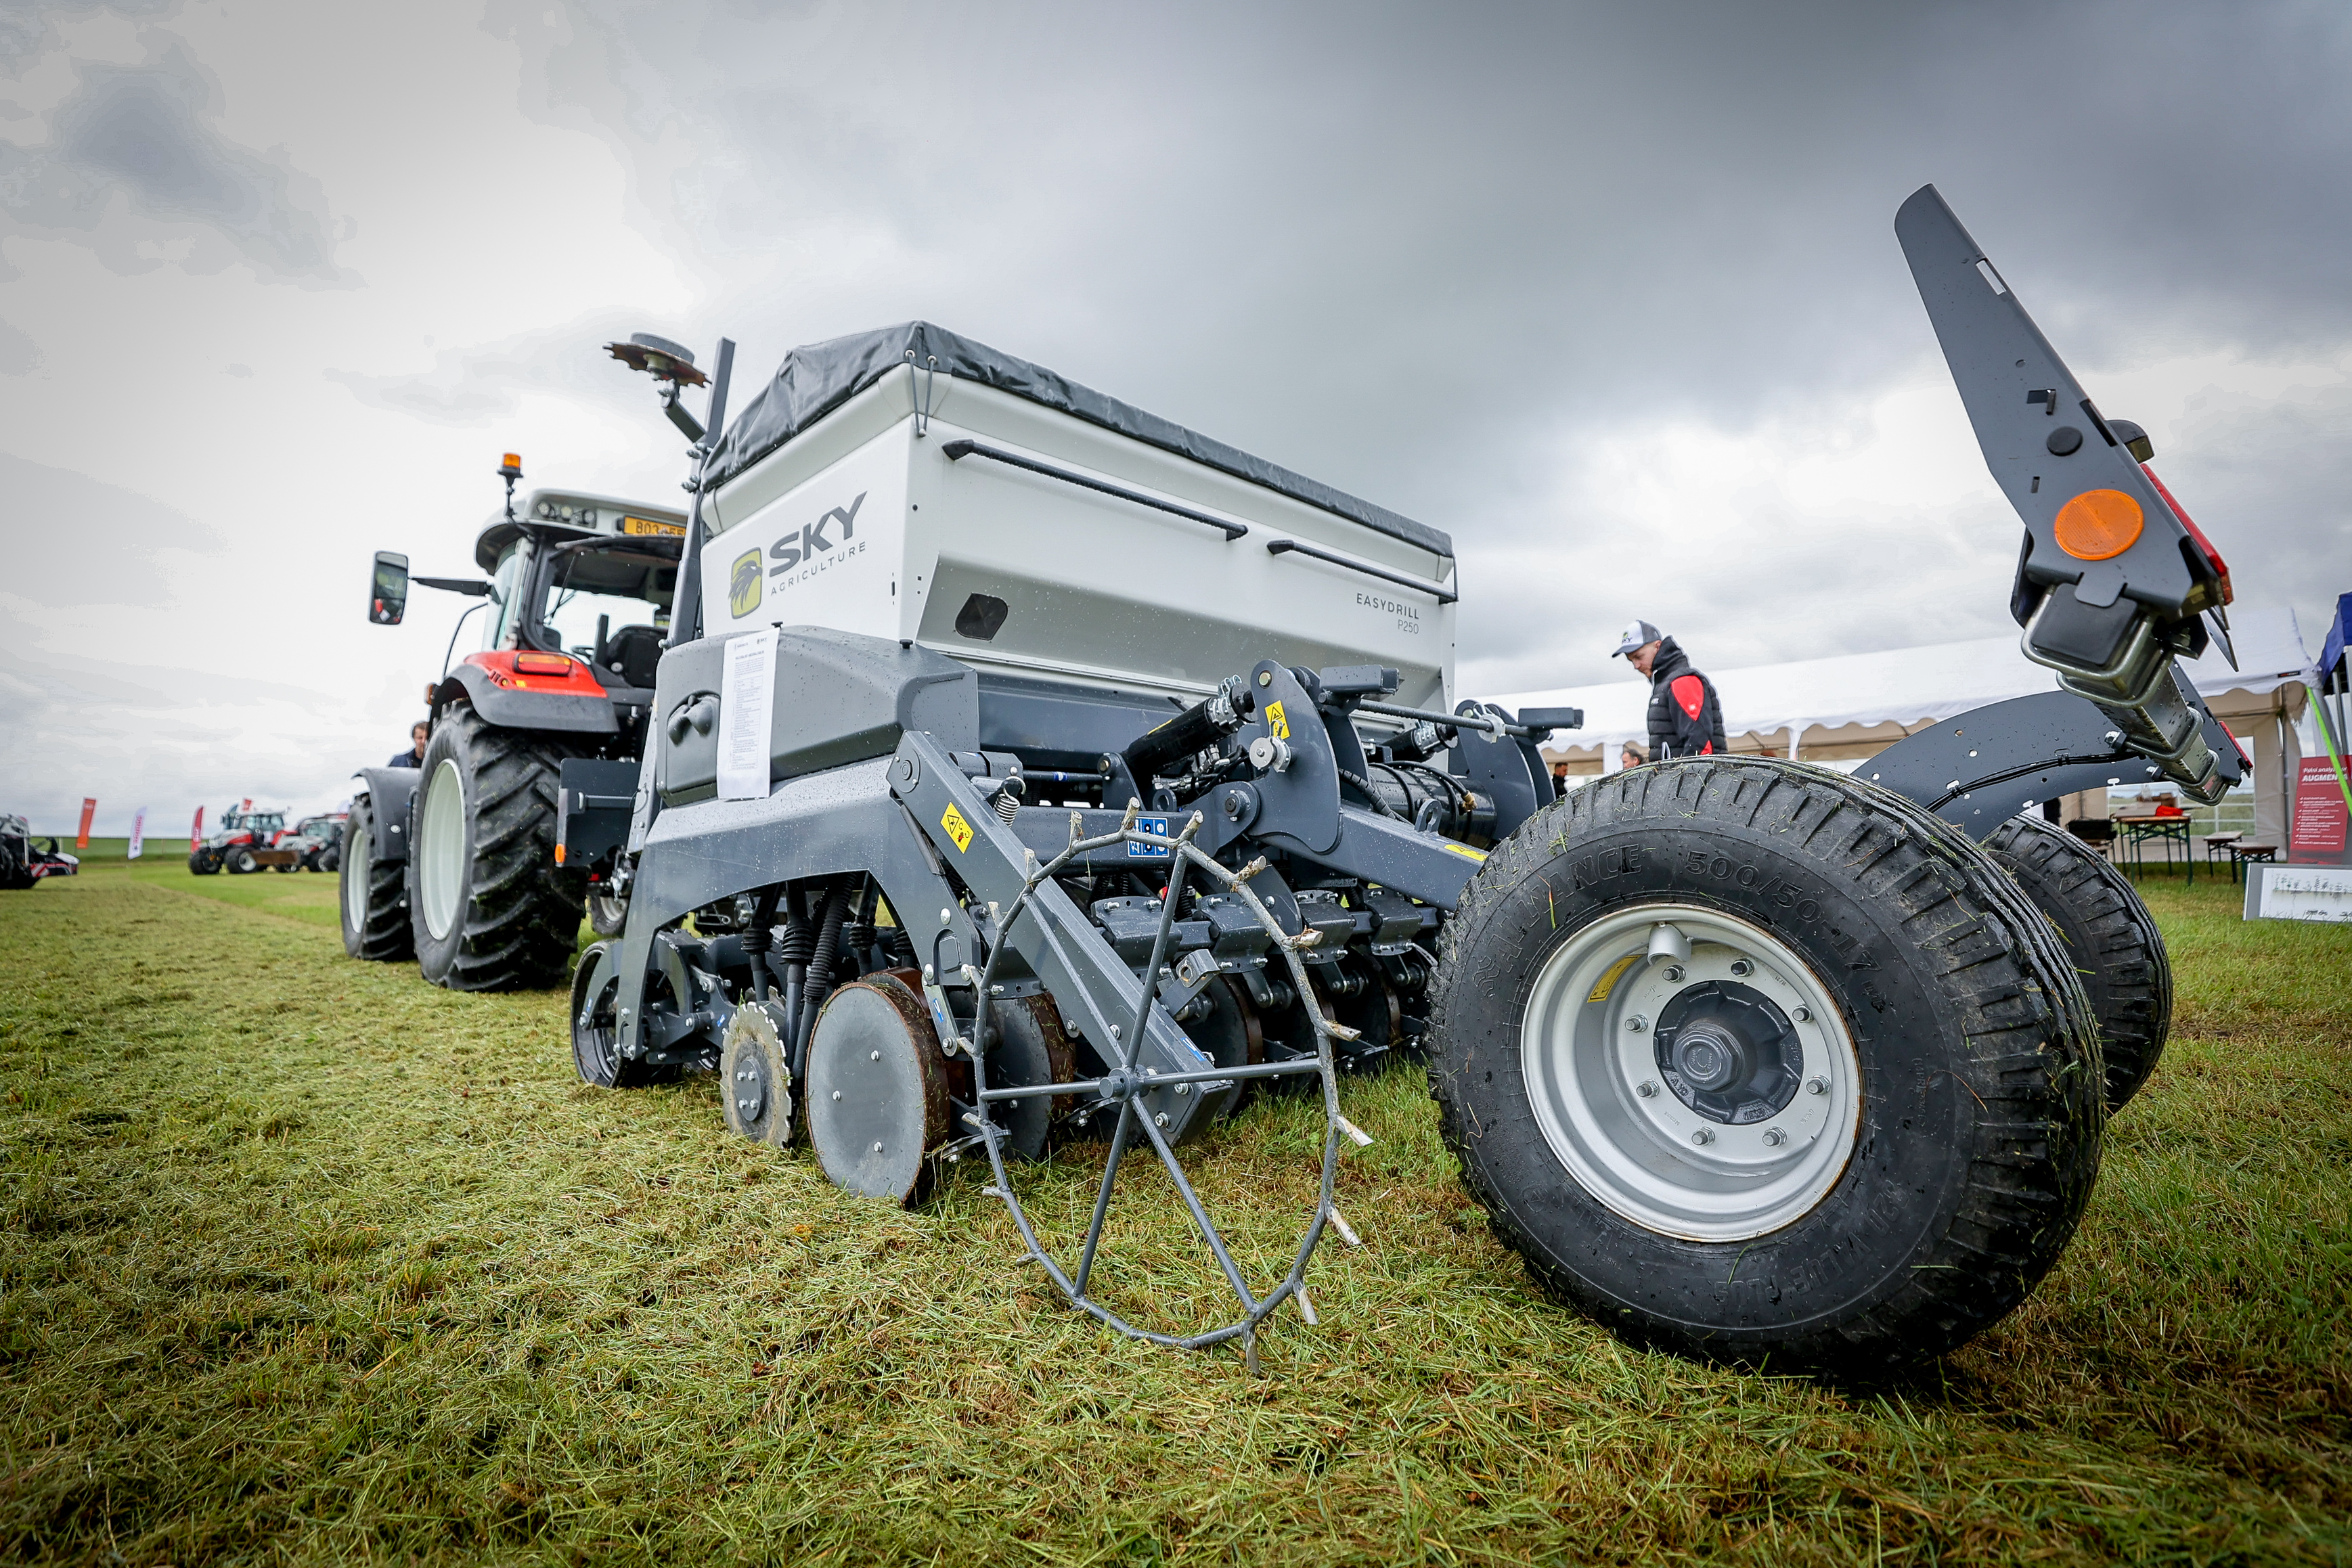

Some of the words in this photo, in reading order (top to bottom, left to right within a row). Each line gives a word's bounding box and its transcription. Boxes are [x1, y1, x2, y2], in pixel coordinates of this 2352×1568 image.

[769, 491, 868, 577] SKY
[770, 541, 866, 596] AGRICULTURE
[1356, 592, 1419, 620] EASYDRILL
[1398, 619, 1419, 634] P250
[2302, 774, 2348, 782] AUGMENA
